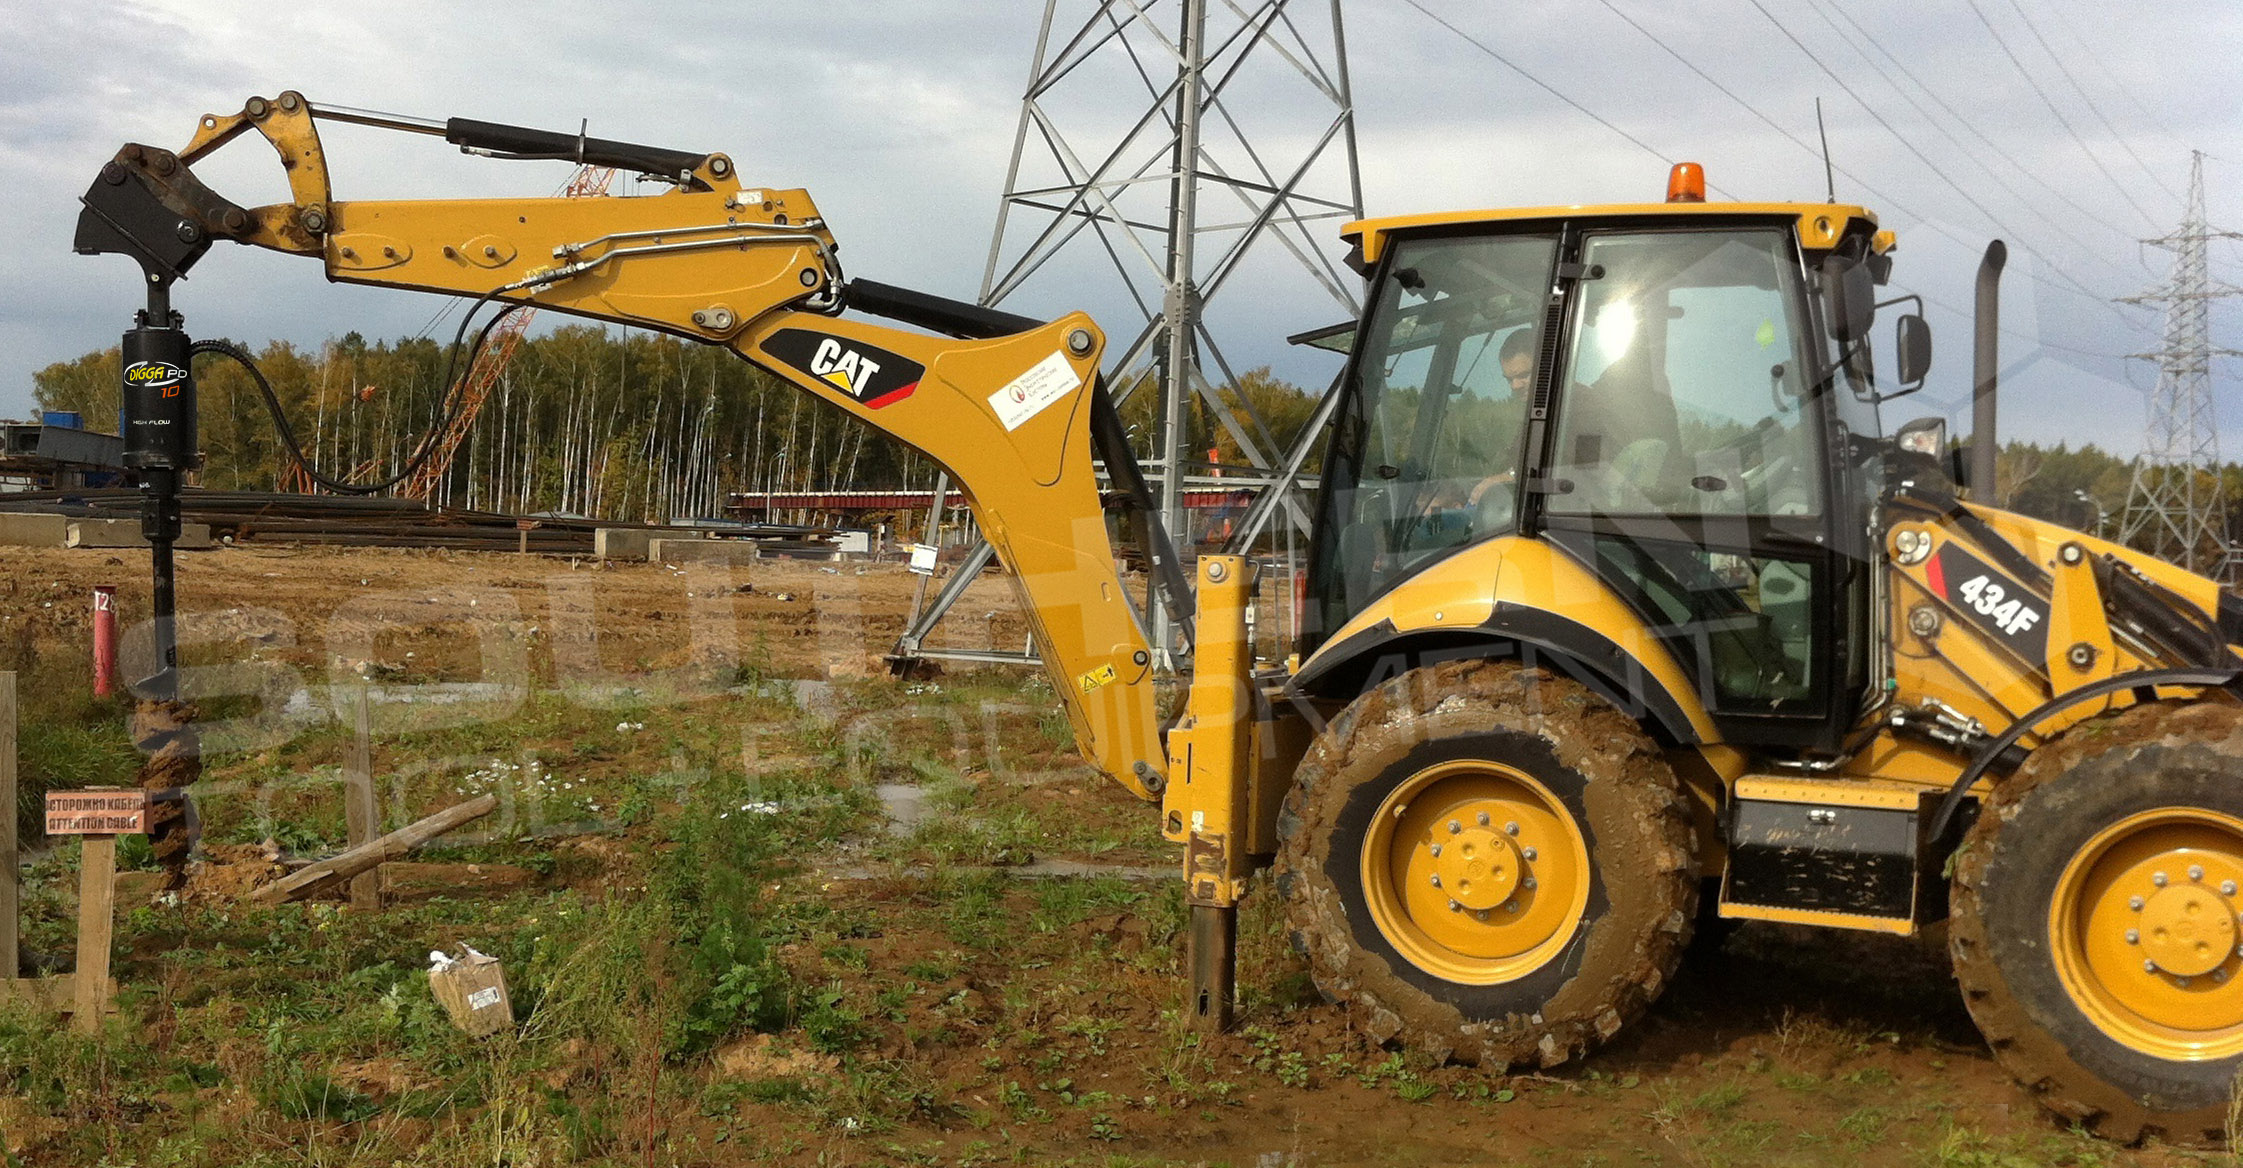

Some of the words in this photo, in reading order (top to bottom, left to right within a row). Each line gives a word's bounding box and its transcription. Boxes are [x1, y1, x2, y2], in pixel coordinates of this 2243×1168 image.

[129, 366, 165, 382] DIGGA
[167, 369, 188, 379] PD
[810, 338, 881, 398] CAT
[161, 385, 180, 399] 10
[1959, 575, 2040, 636] 434F
[48, 817, 105, 830] ATTENTION
[106, 815, 138, 829] CABLE
